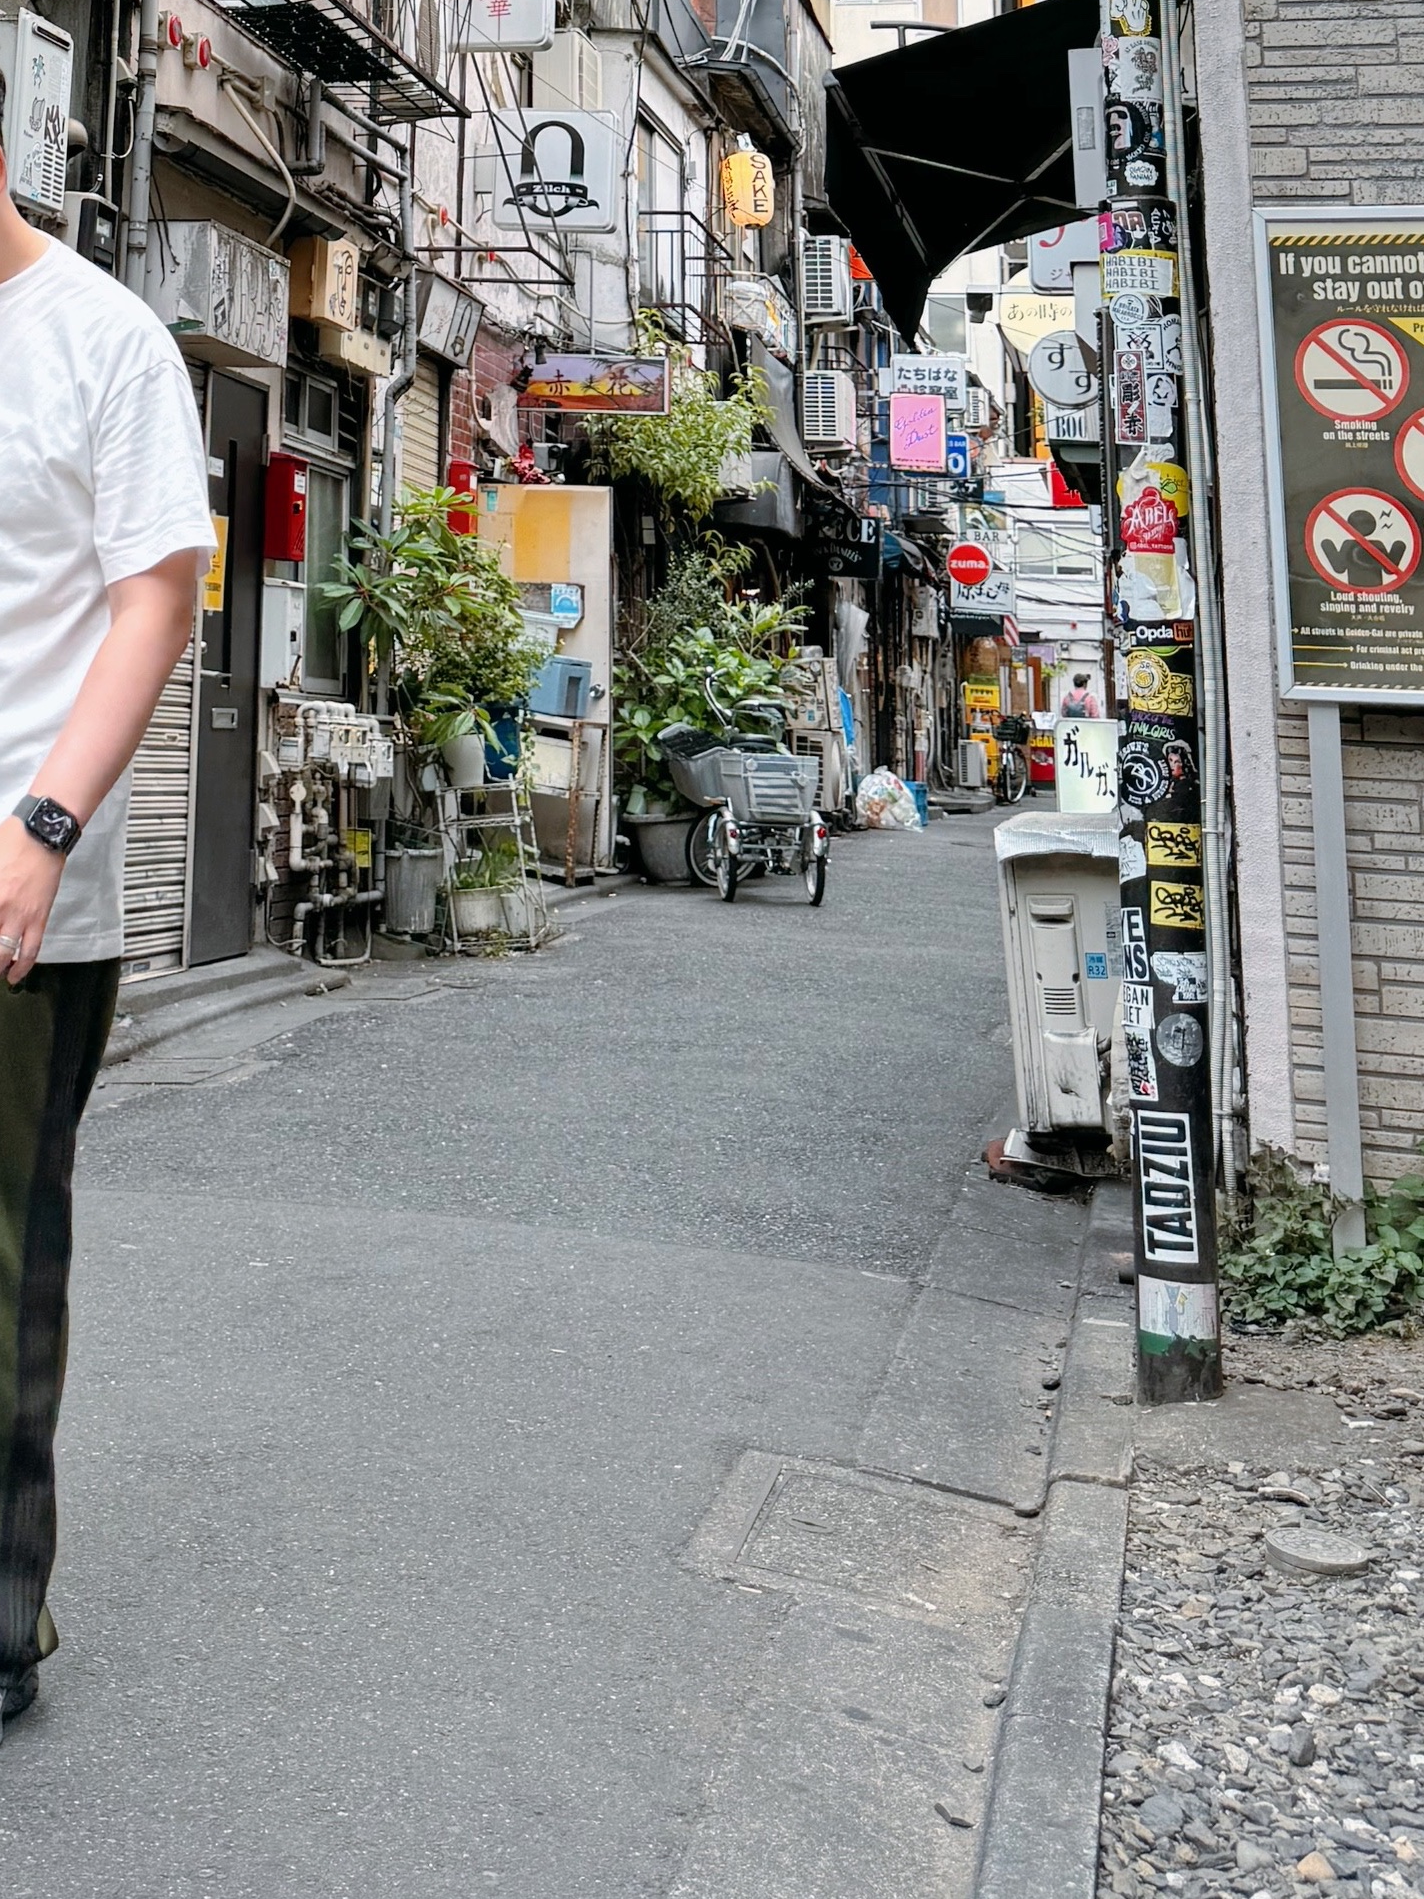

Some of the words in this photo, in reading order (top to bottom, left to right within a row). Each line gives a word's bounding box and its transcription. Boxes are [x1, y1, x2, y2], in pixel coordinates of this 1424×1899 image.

[750, 154, 769, 213] SAKE
[1106, 256, 1156, 268] HABIBI
[1279, 253, 1295, 275] If
[1300, 255, 1343, 278] you
[1347, 252, 1424, 275] cannot
[1106, 267, 1158, 279] HABIBI
[1106, 278, 1160, 290] HABIBI
[1312, 278, 1360, 303] stay
[1367, 278, 1404, 300] out
[1410, 278, 1424, 300] o
[897, 367, 958, 382] たちばな
[1334, 419, 1377, 432] Smoking
[1323, 431, 1336, 441] on
[1337, 430, 1354, 441] the
[1356, 430, 1390, 441] streets
[974, 532, 1000, 541] BAR
[950, 559, 989, 569] zuma.
[1331, 591, 1355, 603] Loud
[1357, 592, 1403, 605] shouting,
[1320, 602, 1357, 615] singing
[1359, 602, 1378, 614] and
[1379, 603, 1415, 616] revelry
[1136, 626, 1173, 642] Opda
[1300, 626, 1311, 636] All
[1312, 626, 1336, 637] streets
[1337, 627, 1345, 636] in
[1345, 628, 1384, 639] Golden-Gai
[1385, 630, 1397, 639] are
[1398, 629, 1423, 641] private
[1356, 644, 1368, 654] For
[1369, 645, 1396, 655] criminal
[1397, 646, 1407, 656] act
[1350, 661, 1384, 672] Drinking
[1385, 662, 1408, 672] under
[1409, 662, 1423, 672] the
[1088, 965, 1106, 976] R32
[1140, 1114, 1194, 1257] TADZIU
